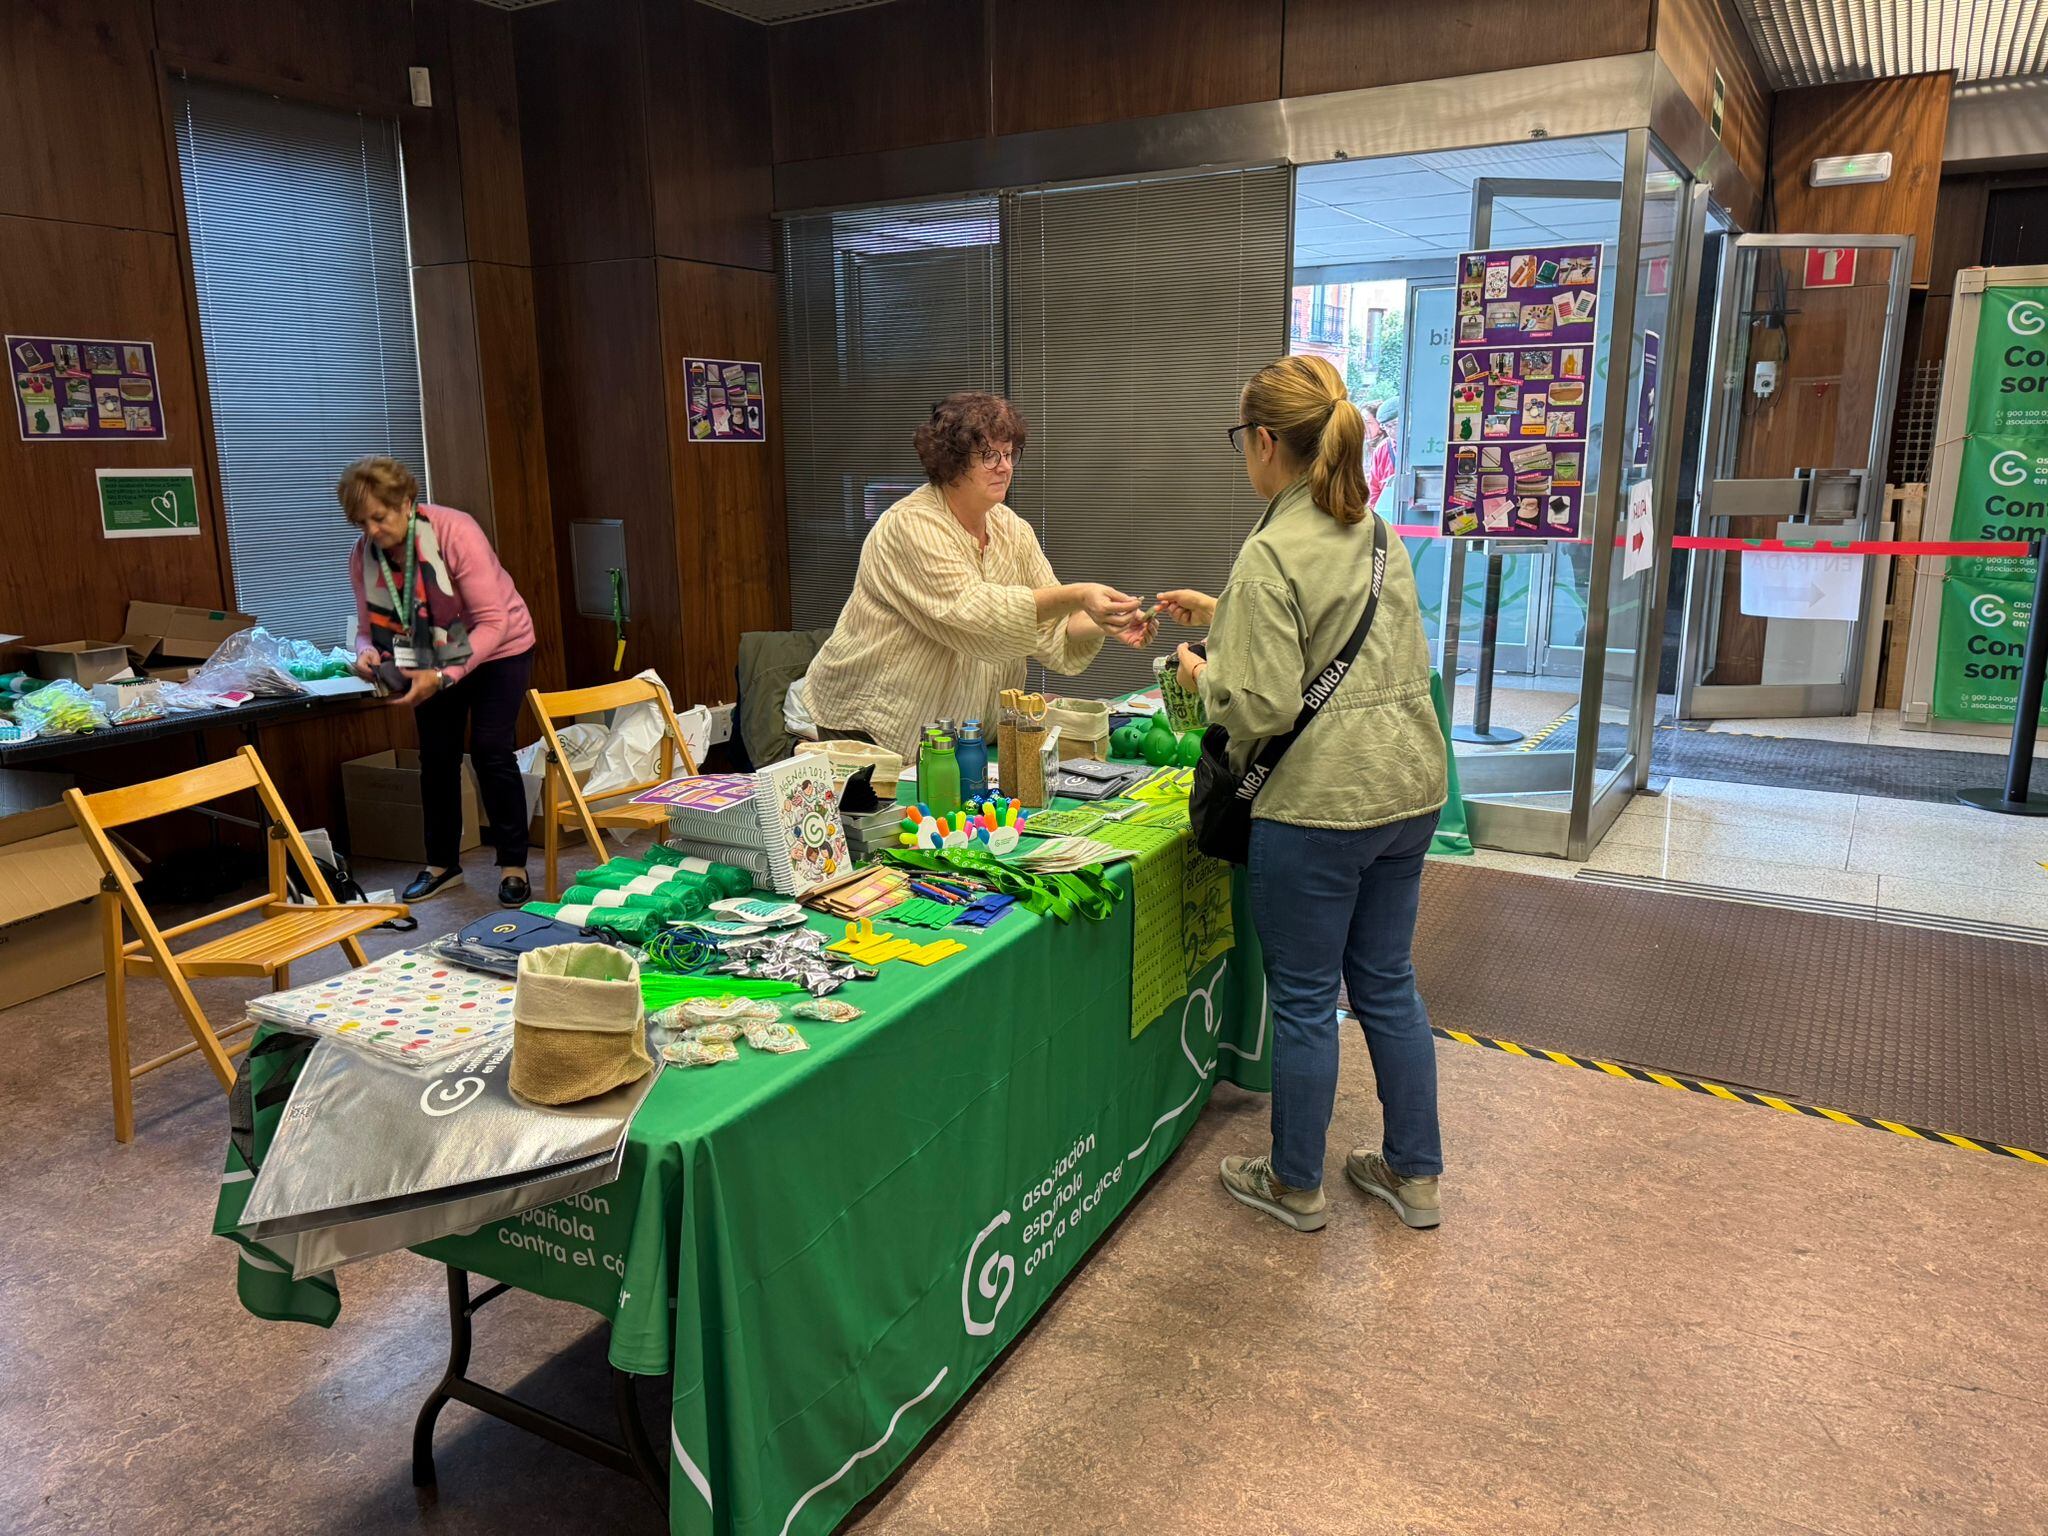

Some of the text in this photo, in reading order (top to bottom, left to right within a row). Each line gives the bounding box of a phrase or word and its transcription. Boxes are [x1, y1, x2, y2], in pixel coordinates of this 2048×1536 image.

[2003, 345, 2048, 367] Co
[1985, 495, 2048, 518] Con
[1372, 547, 1386, 599] BIMBA
[1303, 658, 1349, 710] BIMBA
[1233, 763, 1270, 800] IMBA
[514, 1206, 595, 1242] pañola
[1024, 1220, 1066, 1277] conra
[1070, 1198, 1082, 1228] el
[498, 1227, 567, 1264] contra
[572, 1248, 596, 1267] el
